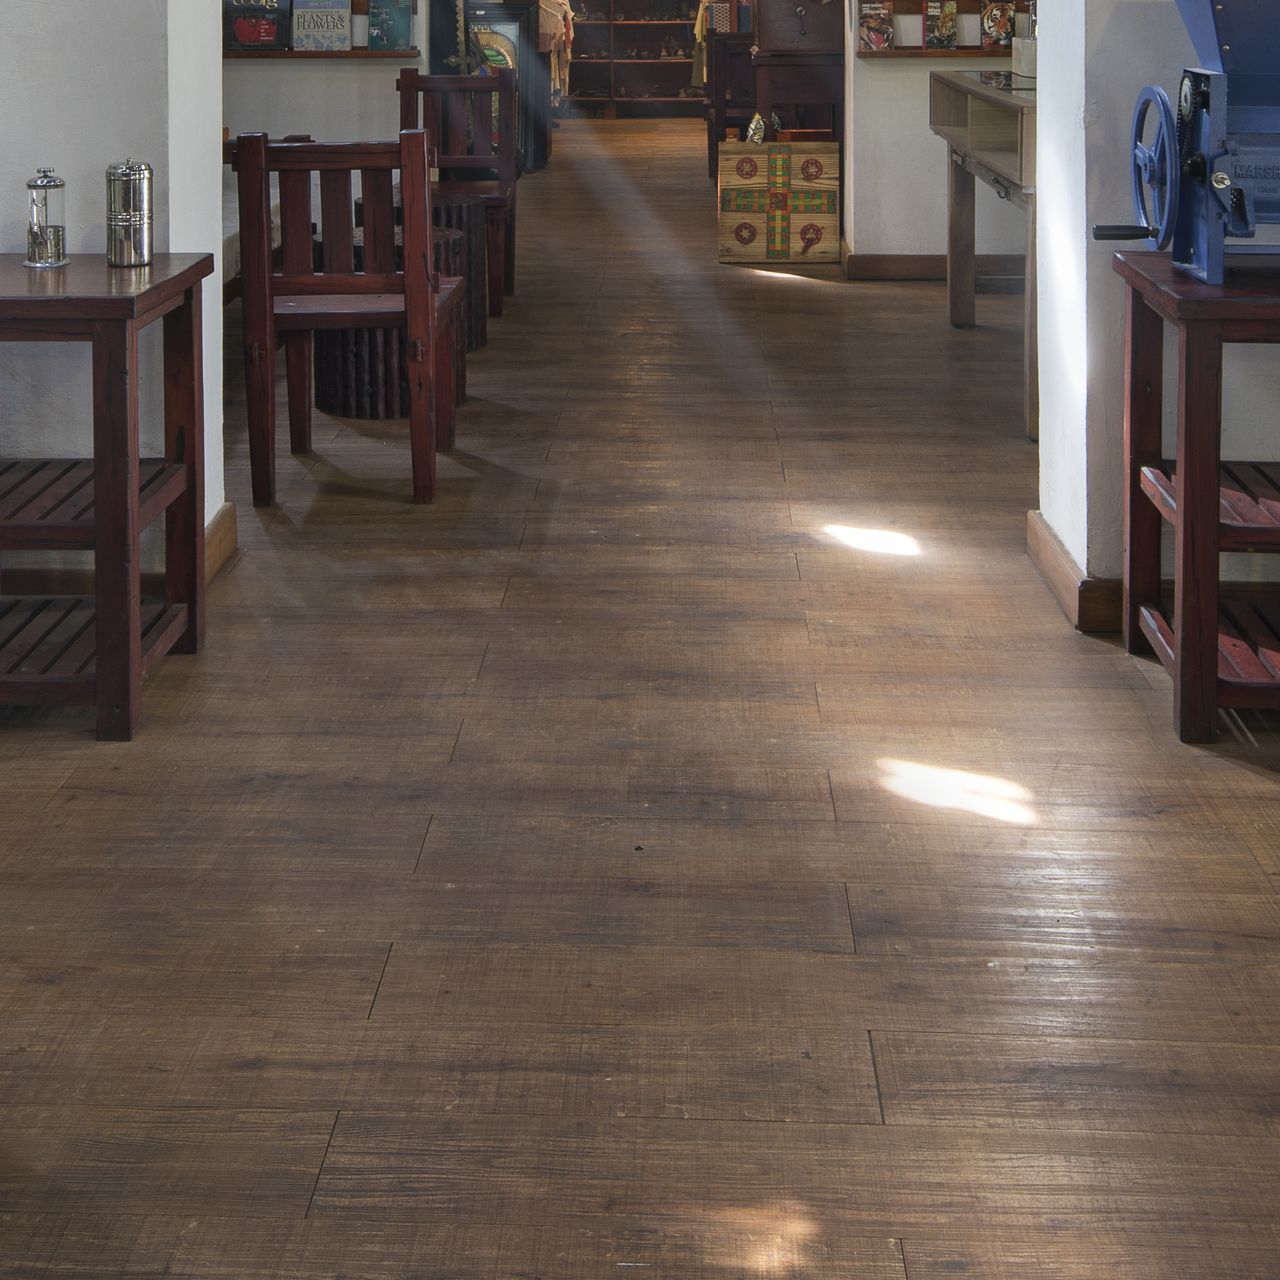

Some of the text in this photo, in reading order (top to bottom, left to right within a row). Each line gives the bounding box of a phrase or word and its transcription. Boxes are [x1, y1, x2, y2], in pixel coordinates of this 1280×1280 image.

[297, 14, 345, 23] PLANTS &
[297, 21, 345, 30] FLOWERS
